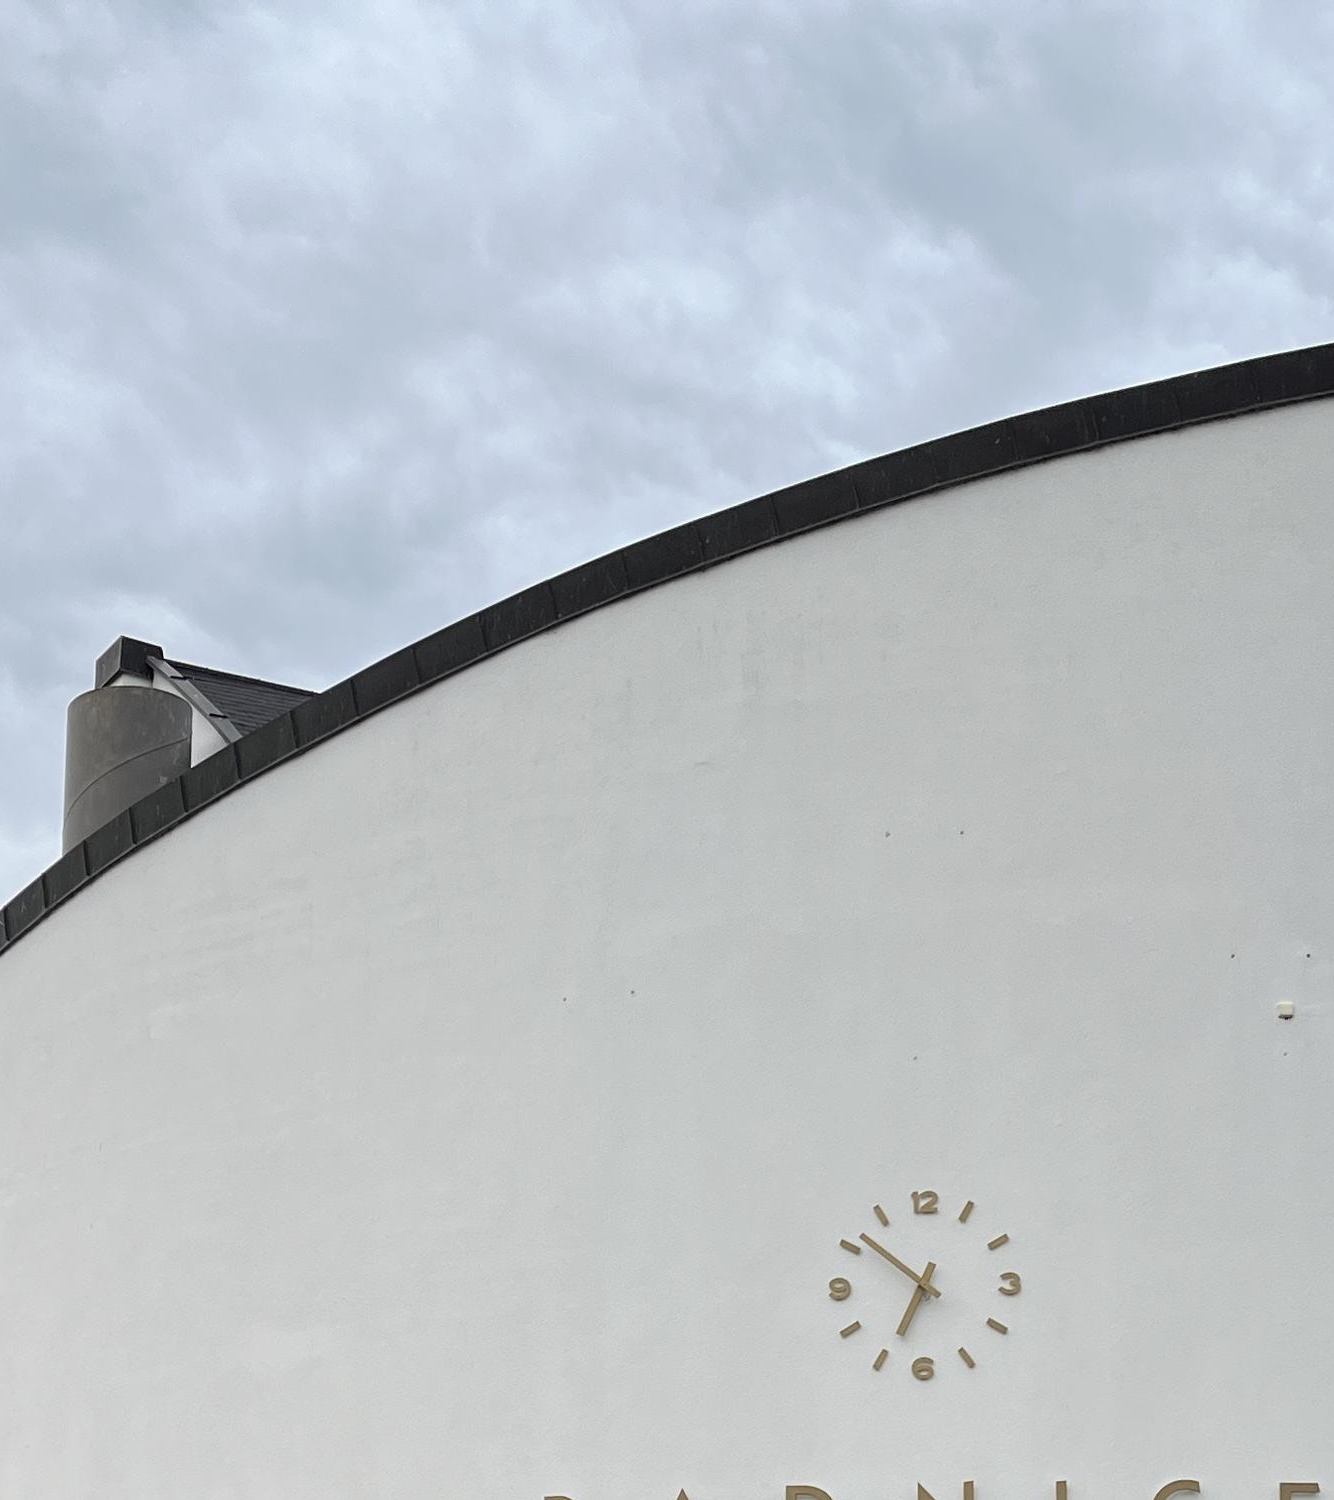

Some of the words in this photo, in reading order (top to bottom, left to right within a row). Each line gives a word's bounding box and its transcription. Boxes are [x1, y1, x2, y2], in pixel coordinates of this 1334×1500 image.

[910, 1190, 940, 1215] 12
[828, 1277, 852, 1301] 9
[998, 1272, 1022, 1296] 3
[911, 1356, 935, 1381] 6
